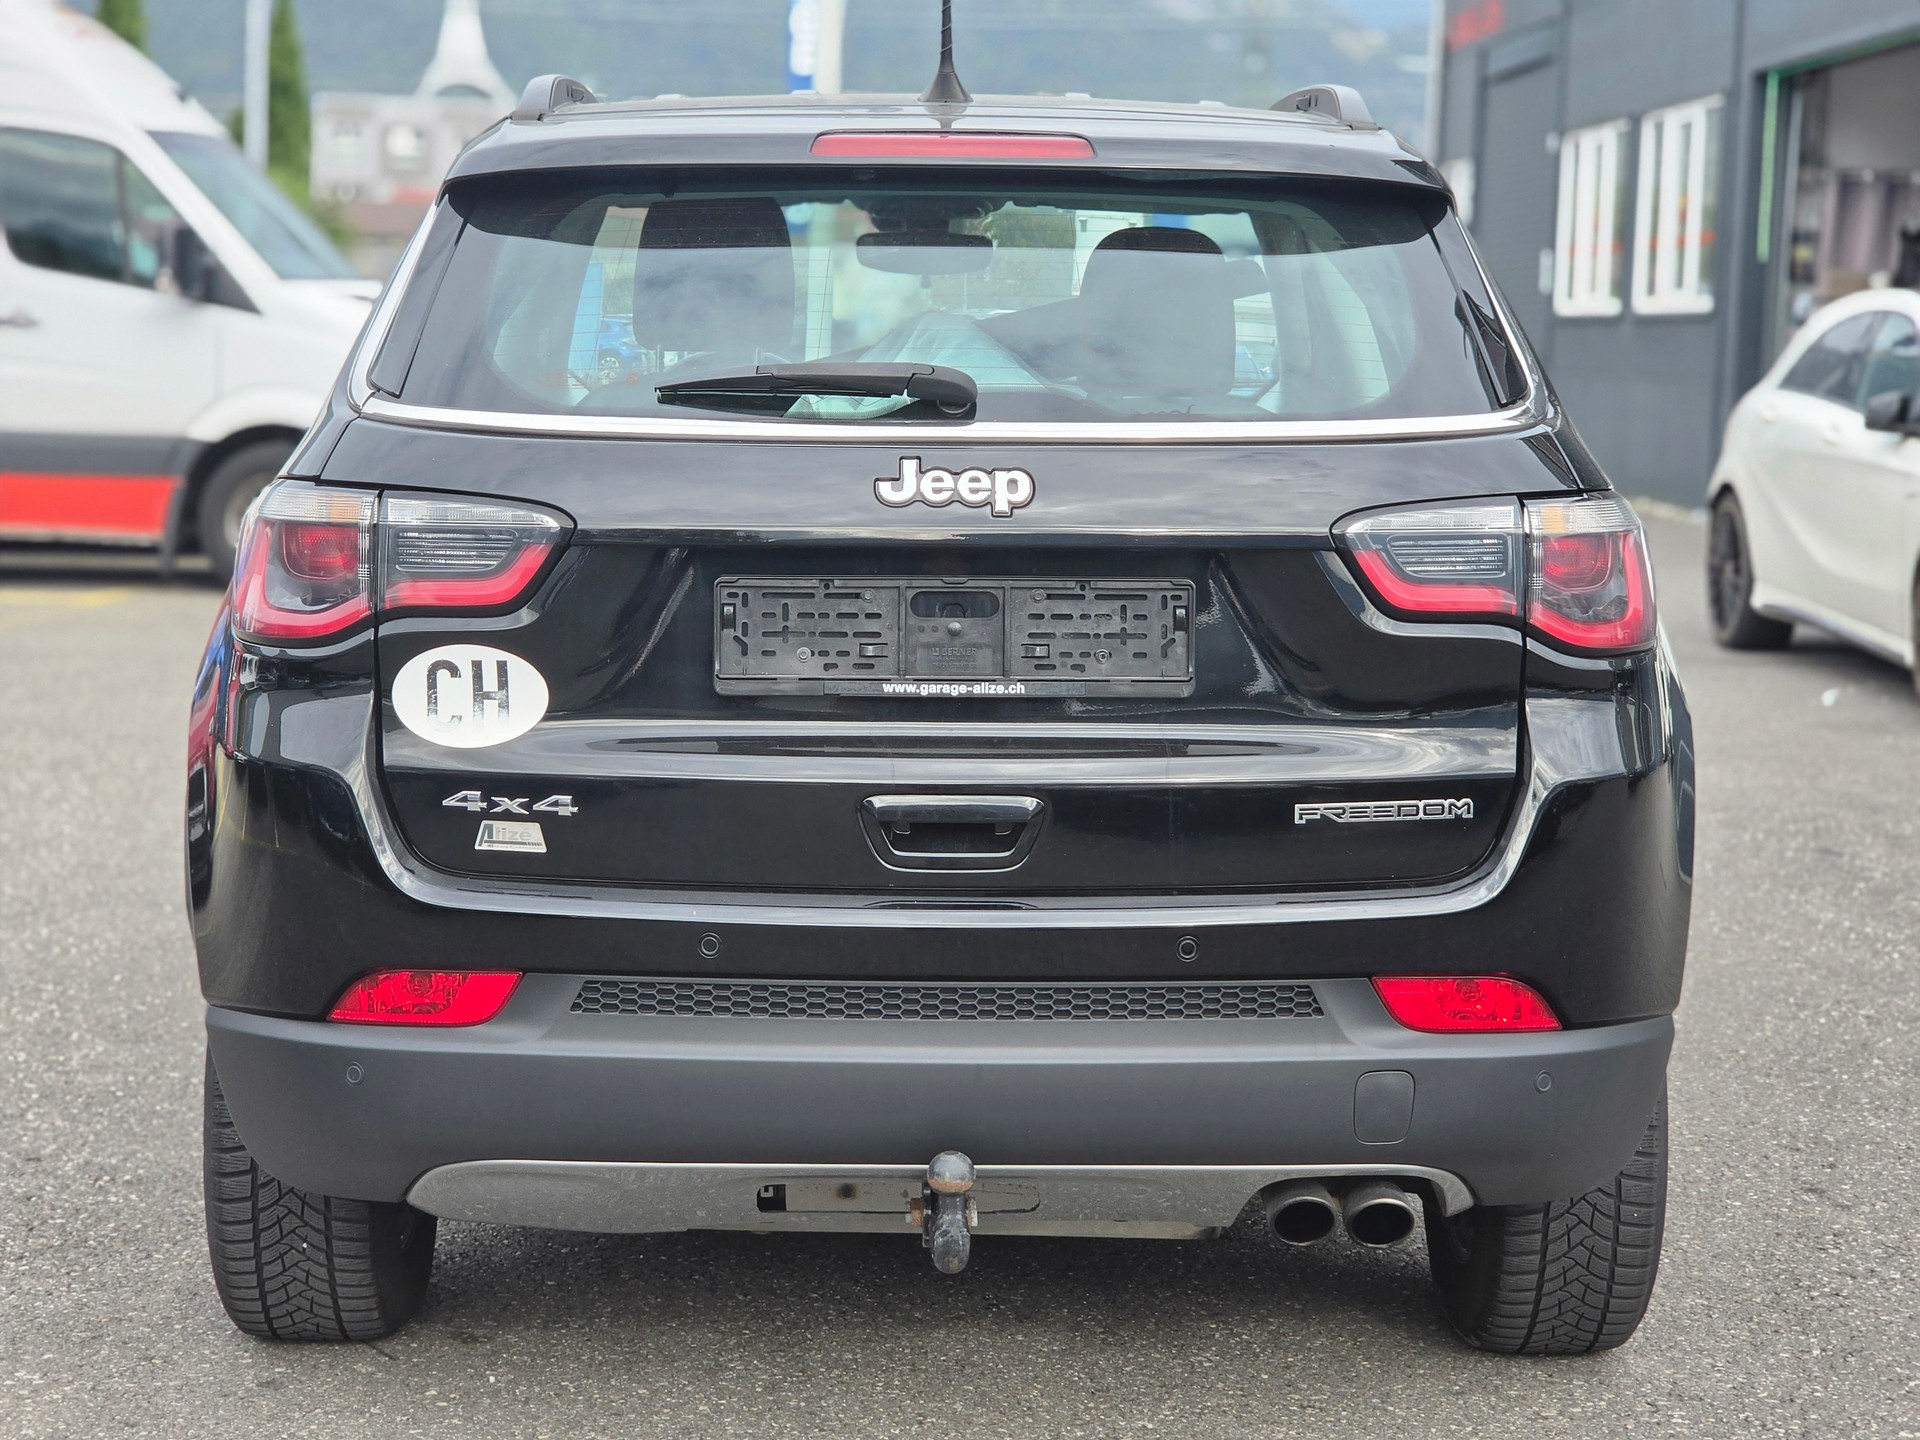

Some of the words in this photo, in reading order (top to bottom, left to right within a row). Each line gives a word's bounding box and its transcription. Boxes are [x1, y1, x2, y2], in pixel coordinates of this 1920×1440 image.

[876, 457, 1033, 516] Jeep
[941, 647, 977, 656] BERNER
[426, 659, 510, 732] CH
[882, 682, 1026, 696] www.garage-alize.ch
[441, 790, 579, 817] 4x4
[1294, 797, 1474, 825] FREEDOM
